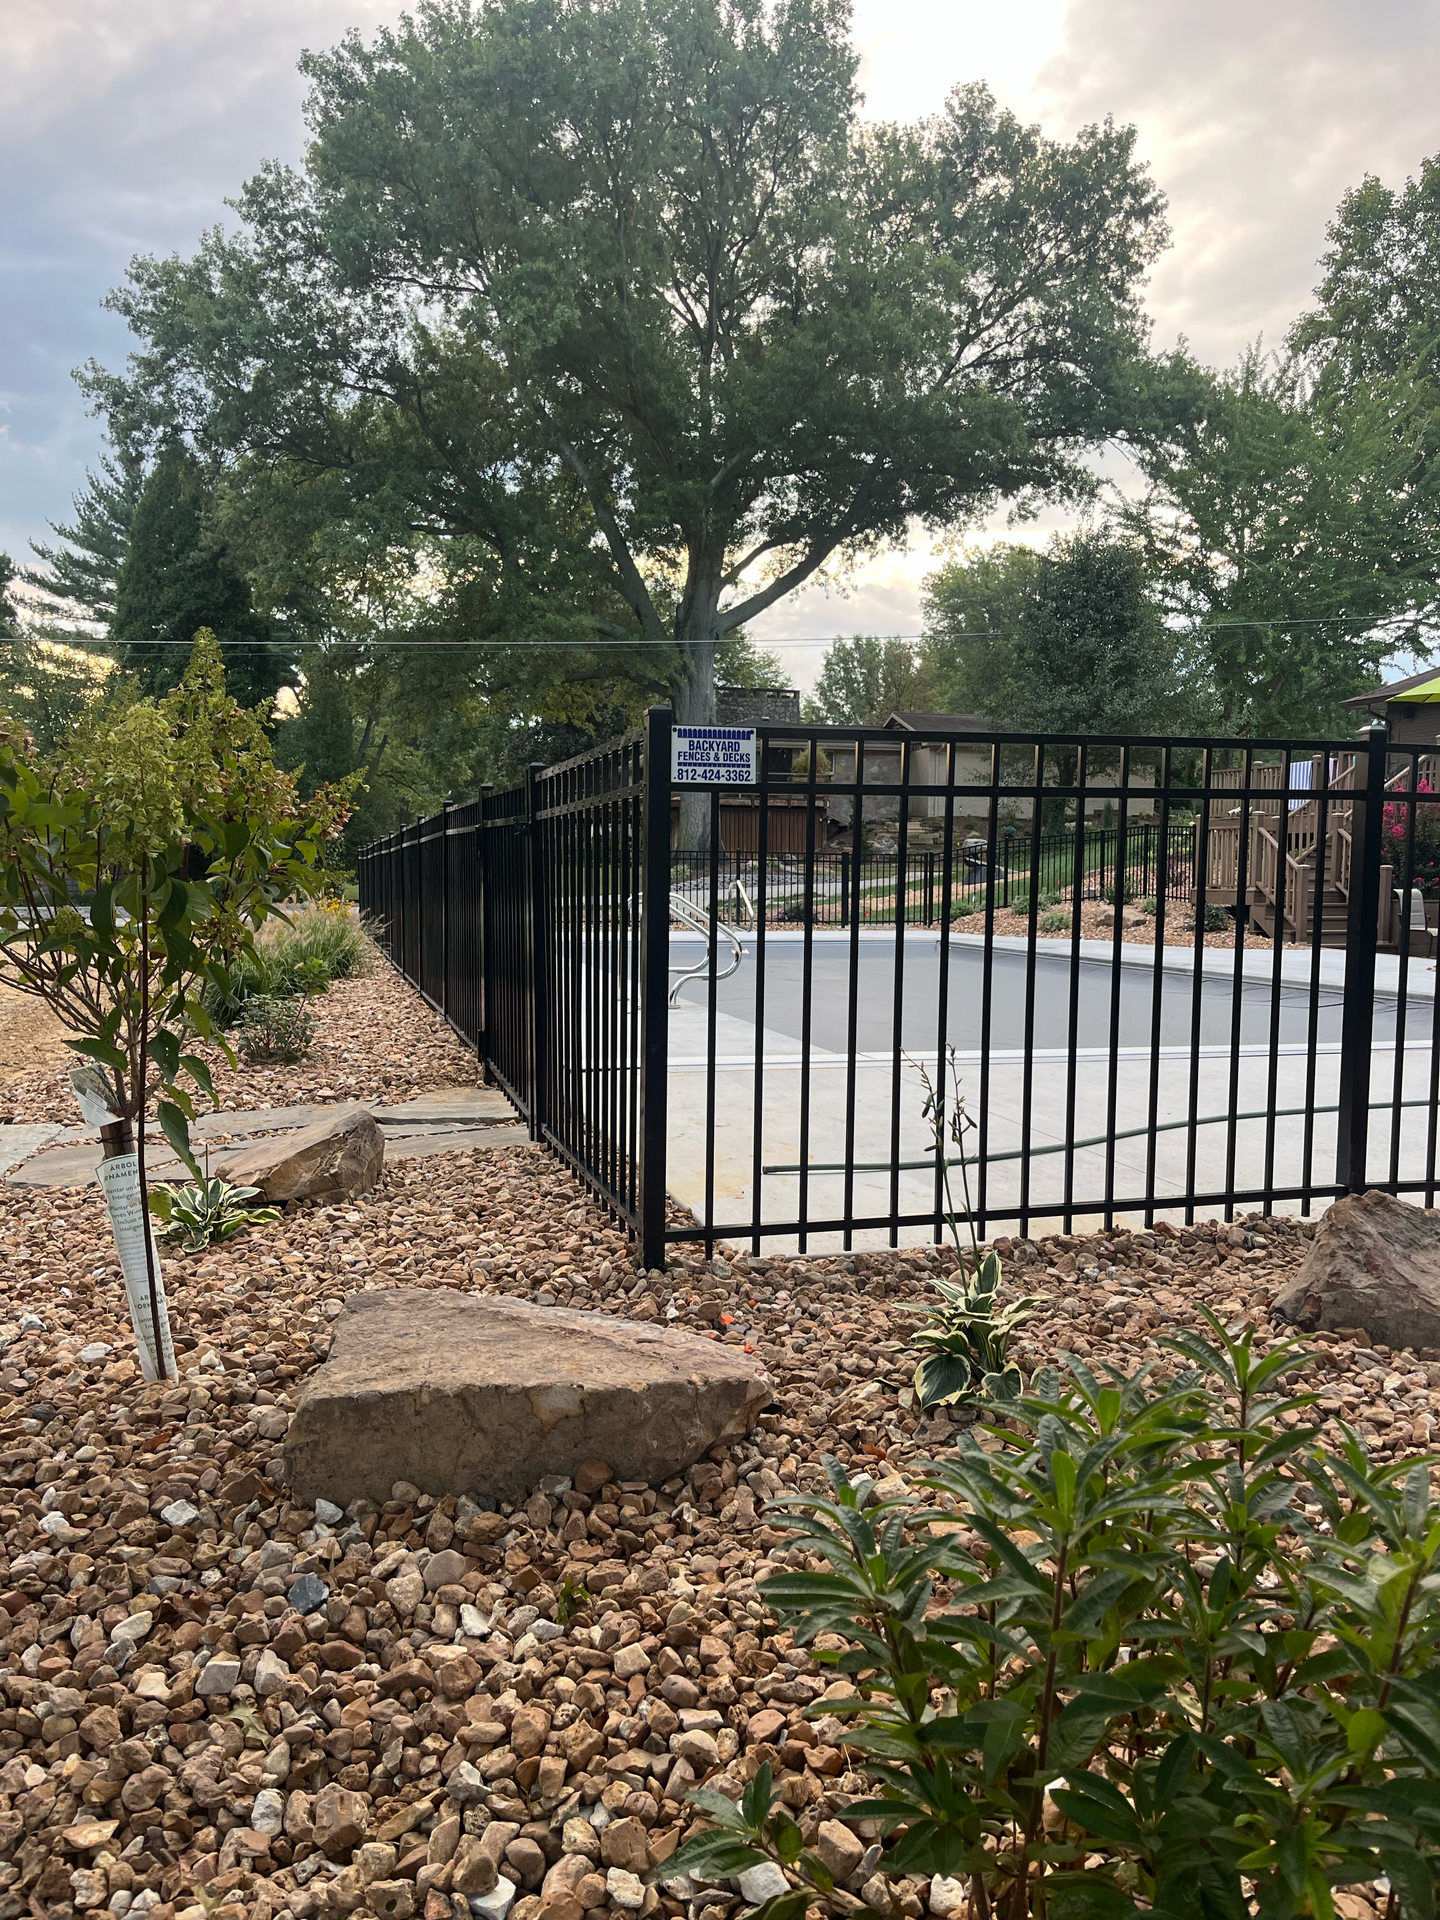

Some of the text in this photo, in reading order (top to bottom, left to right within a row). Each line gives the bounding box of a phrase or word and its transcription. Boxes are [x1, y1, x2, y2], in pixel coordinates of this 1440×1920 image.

[688, 740, 741, 752] BACKYARD
[677, 751, 751, 763] FENCES & DECKS
[677, 768, 751, 782] 812-424-3362
[104, 1169, 138, 1182] RNAMEN
